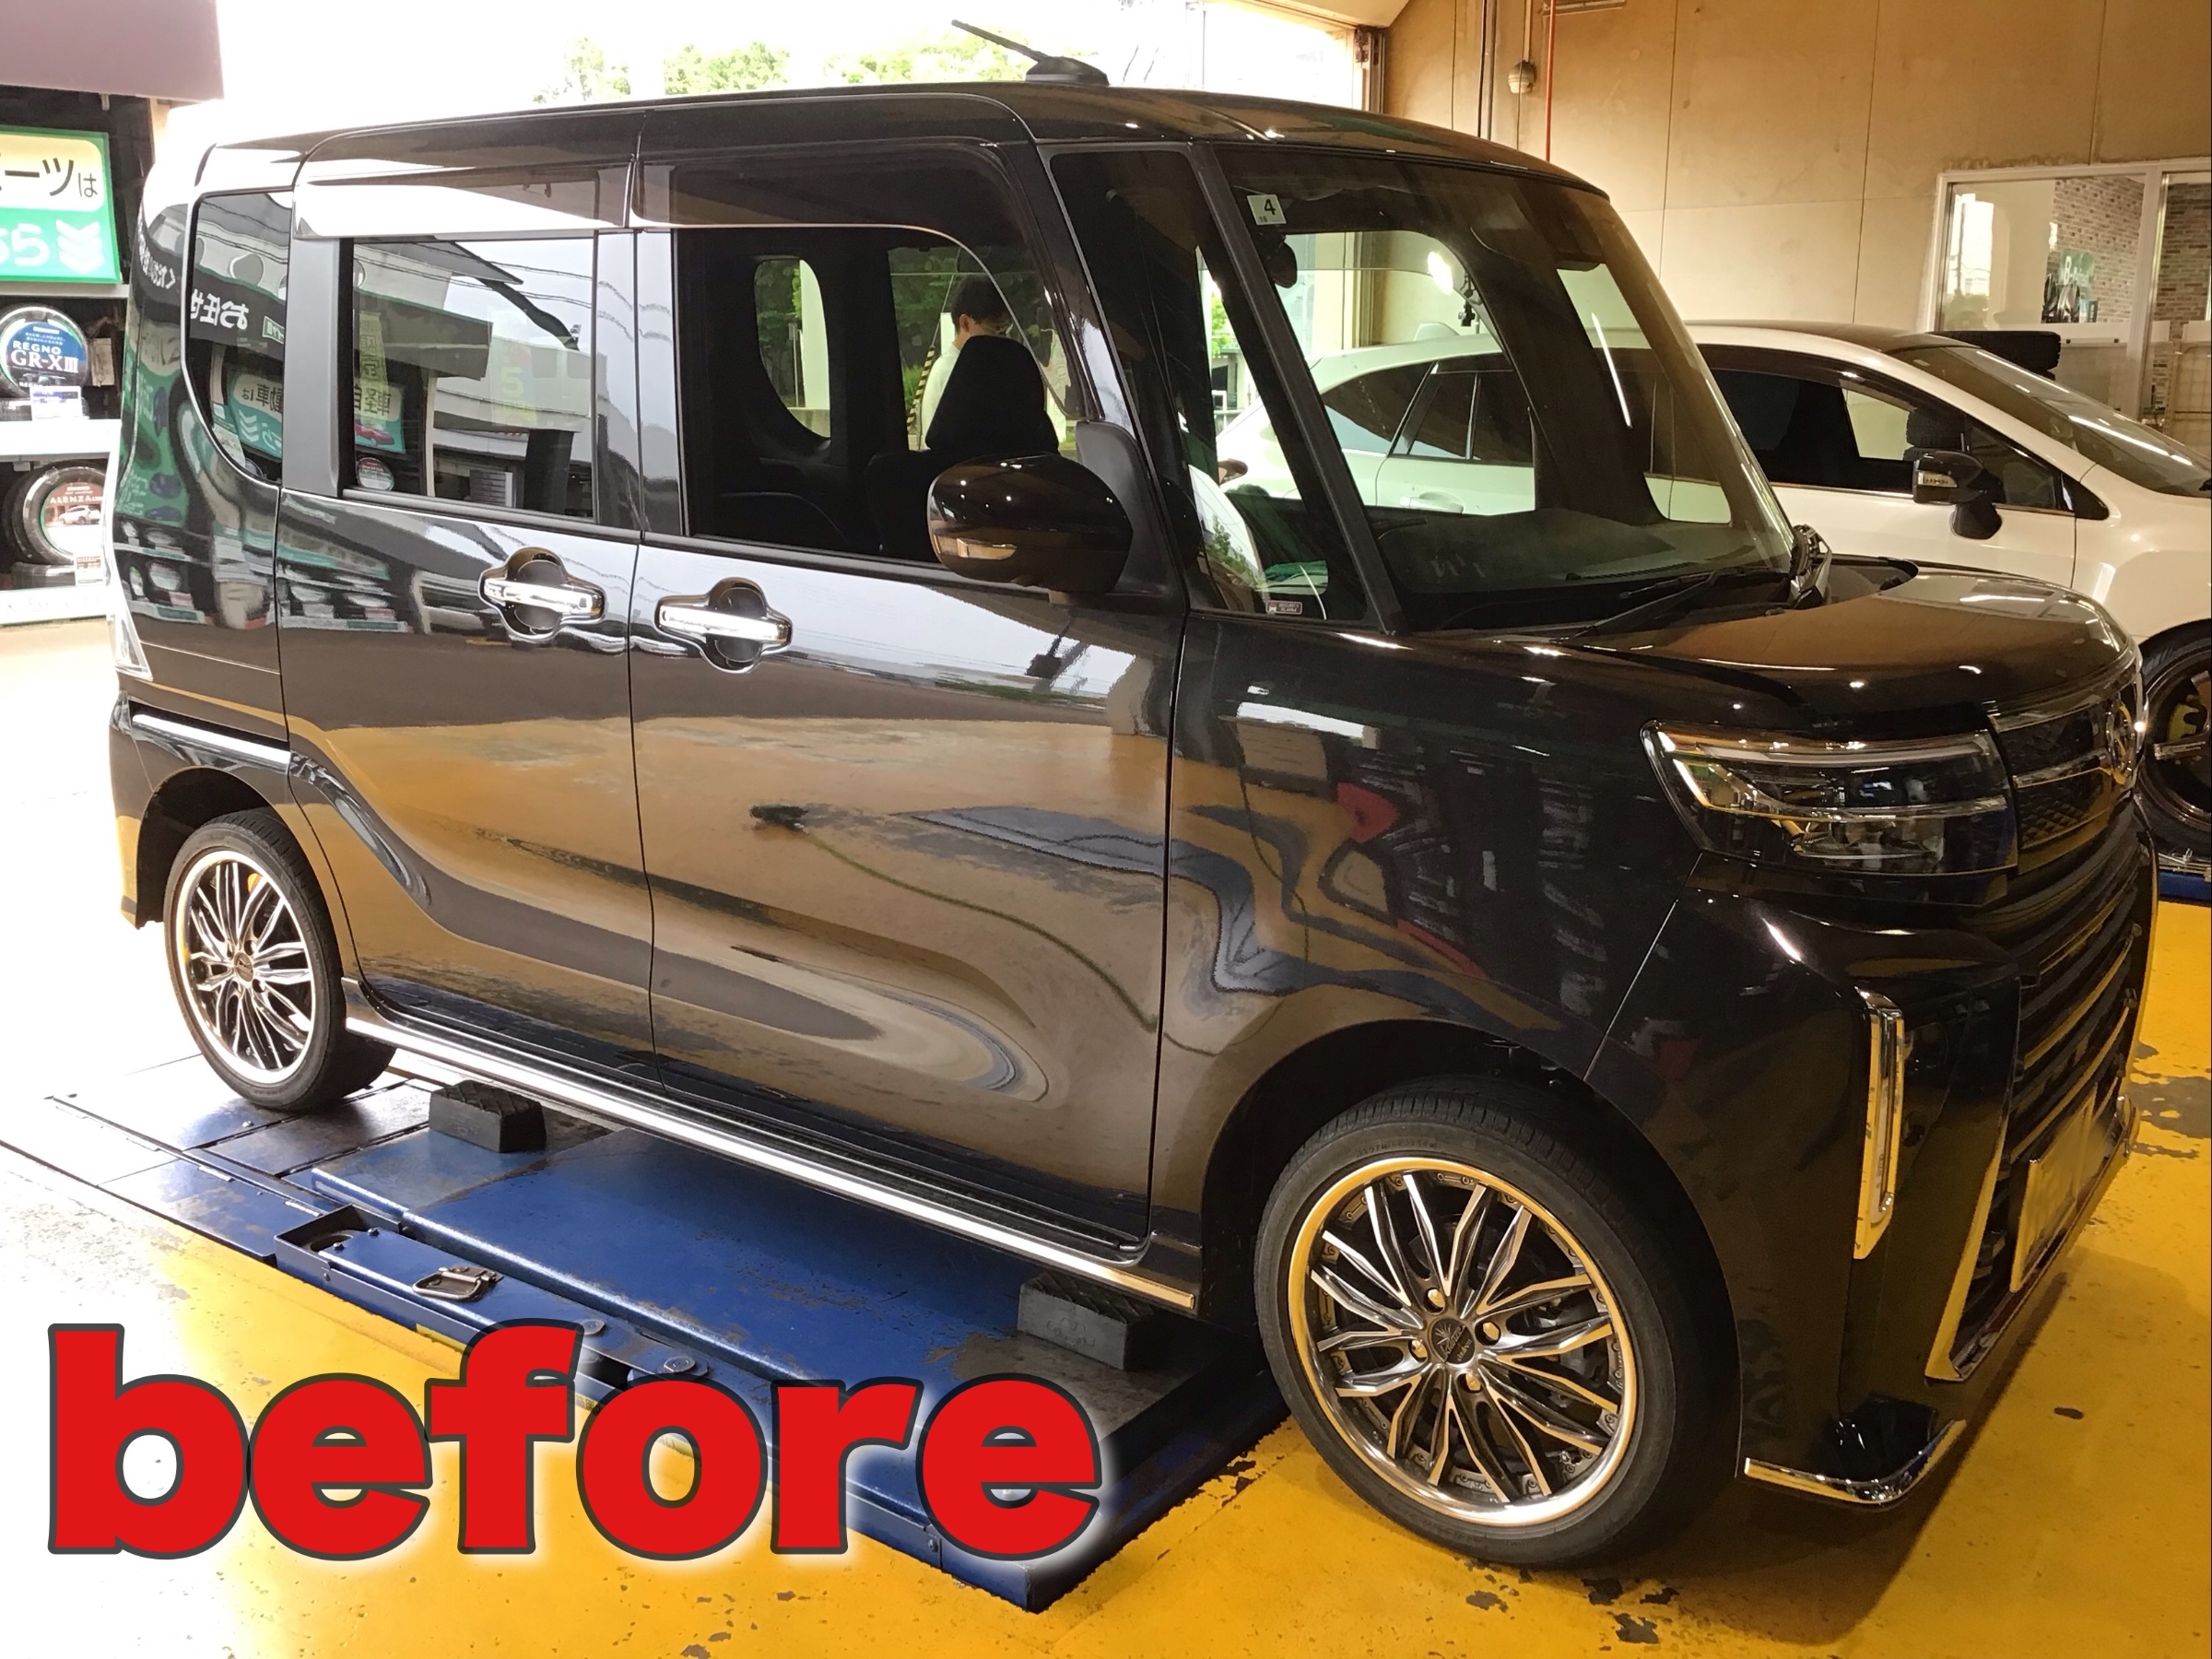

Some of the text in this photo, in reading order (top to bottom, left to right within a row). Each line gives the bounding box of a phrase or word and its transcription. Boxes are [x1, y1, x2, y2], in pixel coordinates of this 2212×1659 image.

[1265, 198, 1276, 216] 4
[0, 222, 51, 266] ら
[12, 339, 62, 356] REGNO
[50, 495, 91, 504] ALENZA
